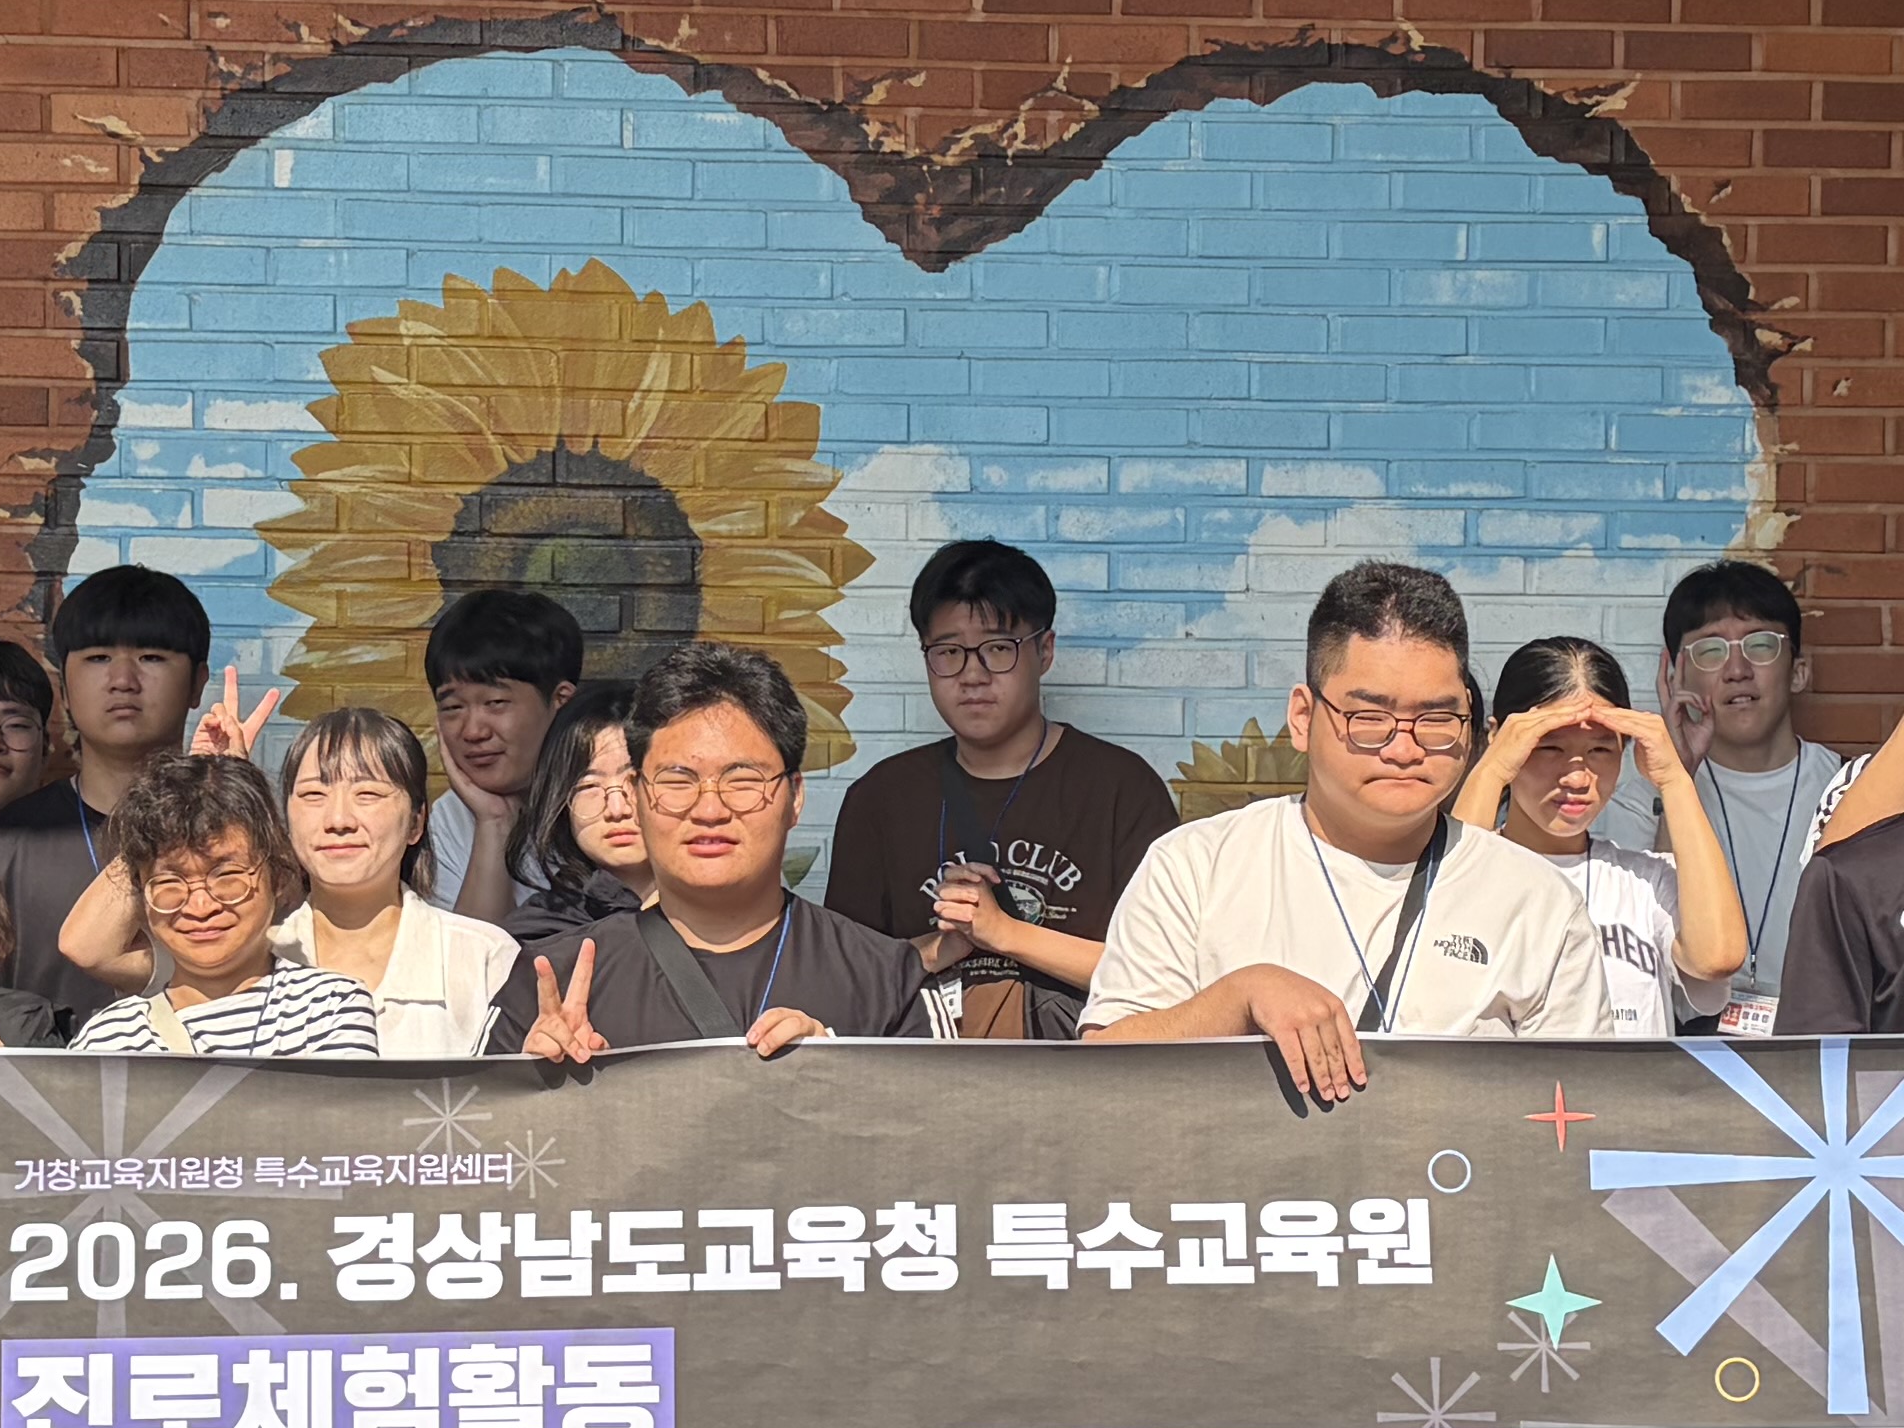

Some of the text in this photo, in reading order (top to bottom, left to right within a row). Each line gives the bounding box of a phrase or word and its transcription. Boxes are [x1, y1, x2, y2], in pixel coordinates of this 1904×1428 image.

[1008, 839, 1082, 892] CLUB
[13, 1150, 514, 1192] 거창교육지원청 특수교육지원센터
[9, 1198, 1434, 1302] 2026. 경상남도교육청 특수교육원
